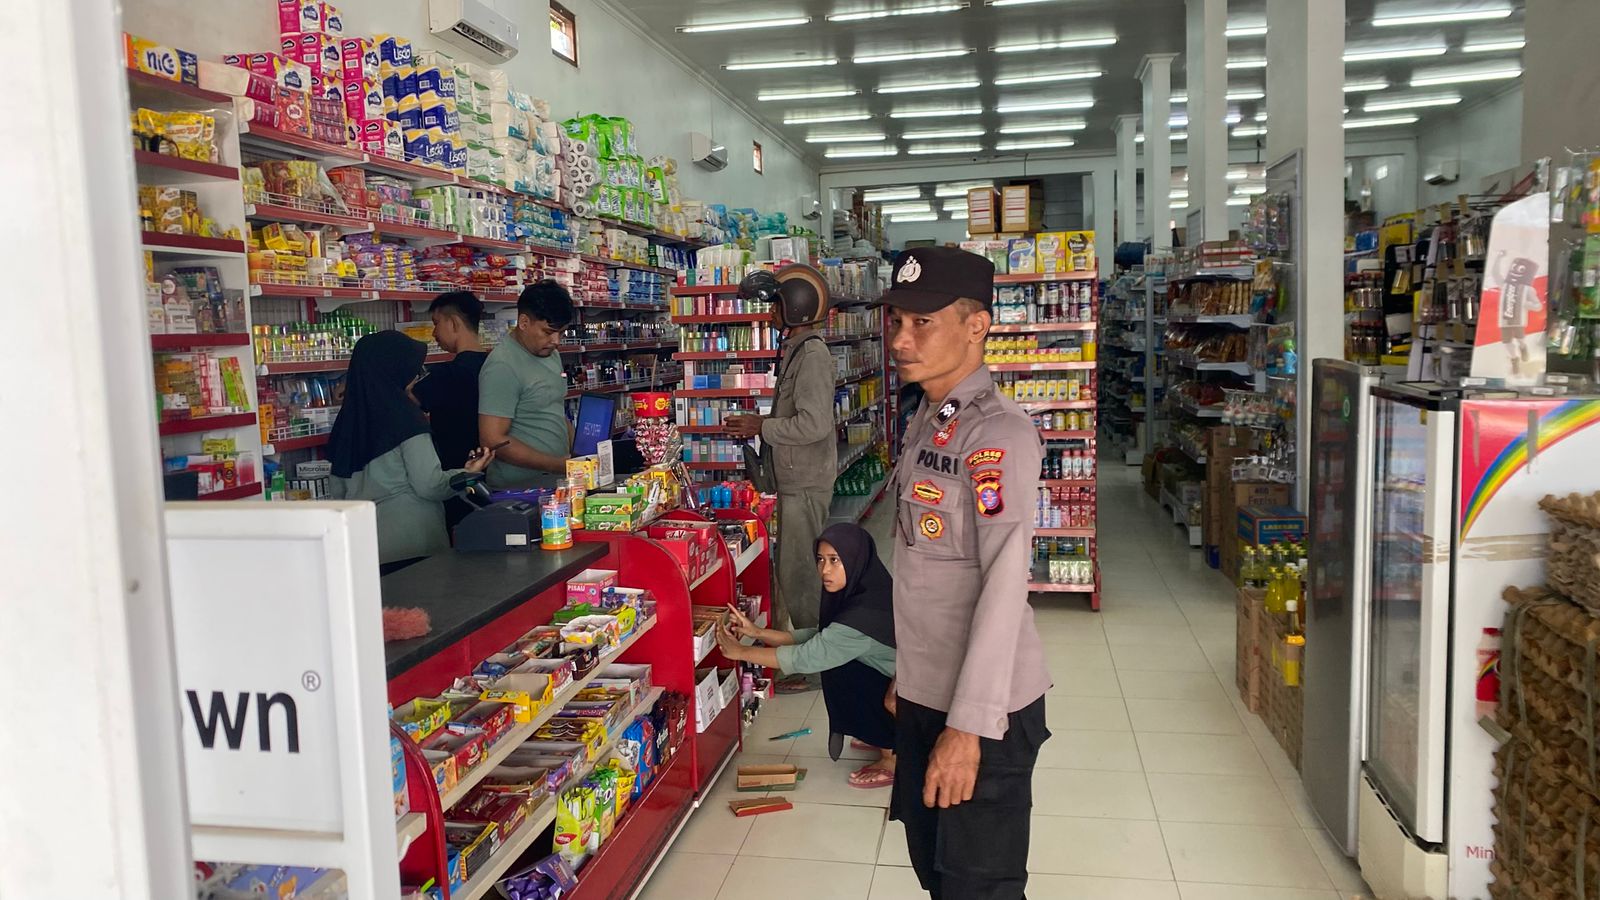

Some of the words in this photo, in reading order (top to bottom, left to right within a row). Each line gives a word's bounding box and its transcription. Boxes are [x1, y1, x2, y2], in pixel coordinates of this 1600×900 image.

[917, 449, 959, 476] POLRI
[184, 689, 300, 754] wn
[1466, 846, 1496, 860] Min
